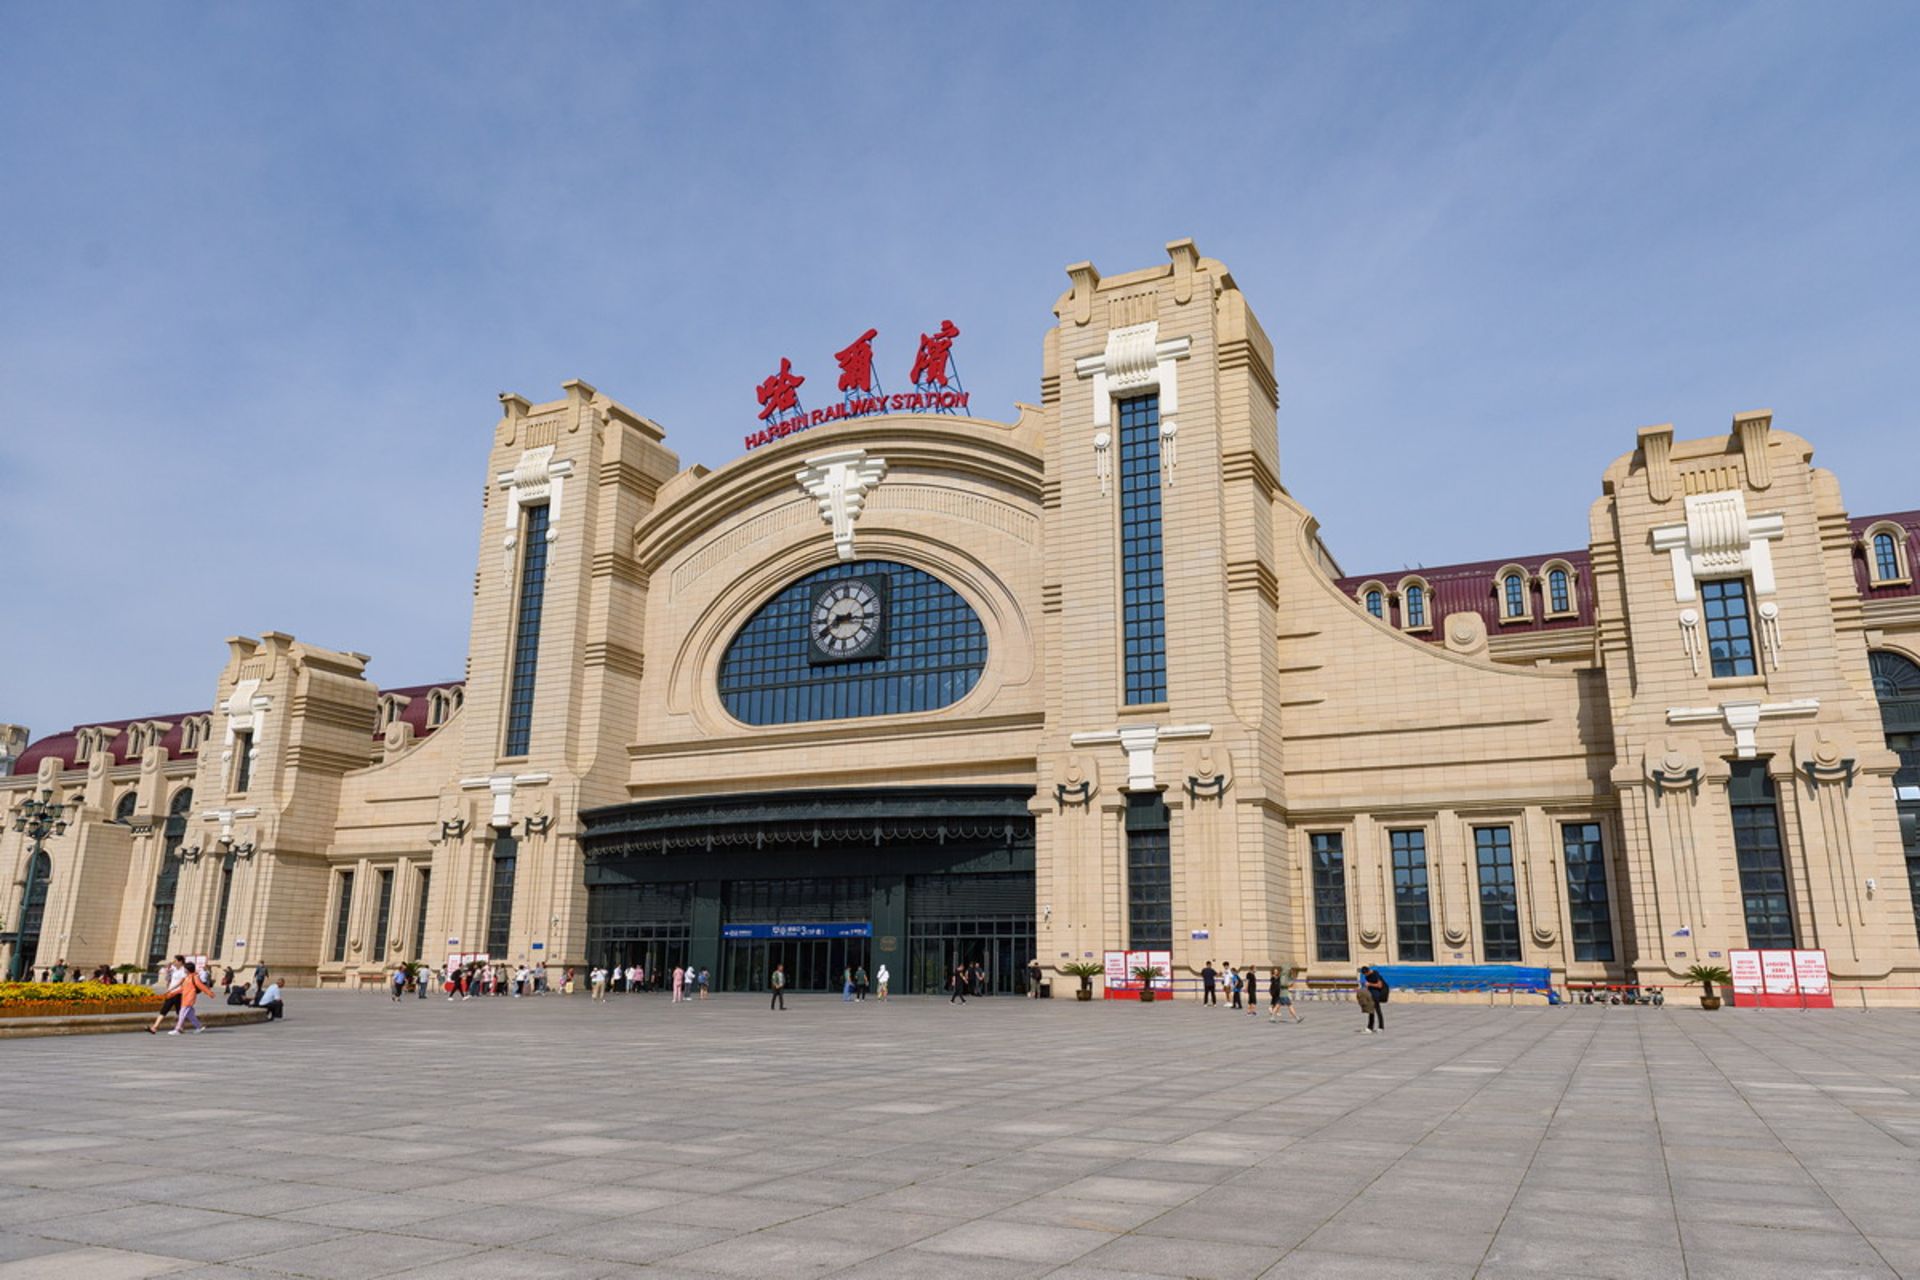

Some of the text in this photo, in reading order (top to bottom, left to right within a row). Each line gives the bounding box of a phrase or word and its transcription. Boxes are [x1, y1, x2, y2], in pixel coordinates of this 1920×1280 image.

[744, 391, 969, 450] HARBIN RAILWAY STATION
